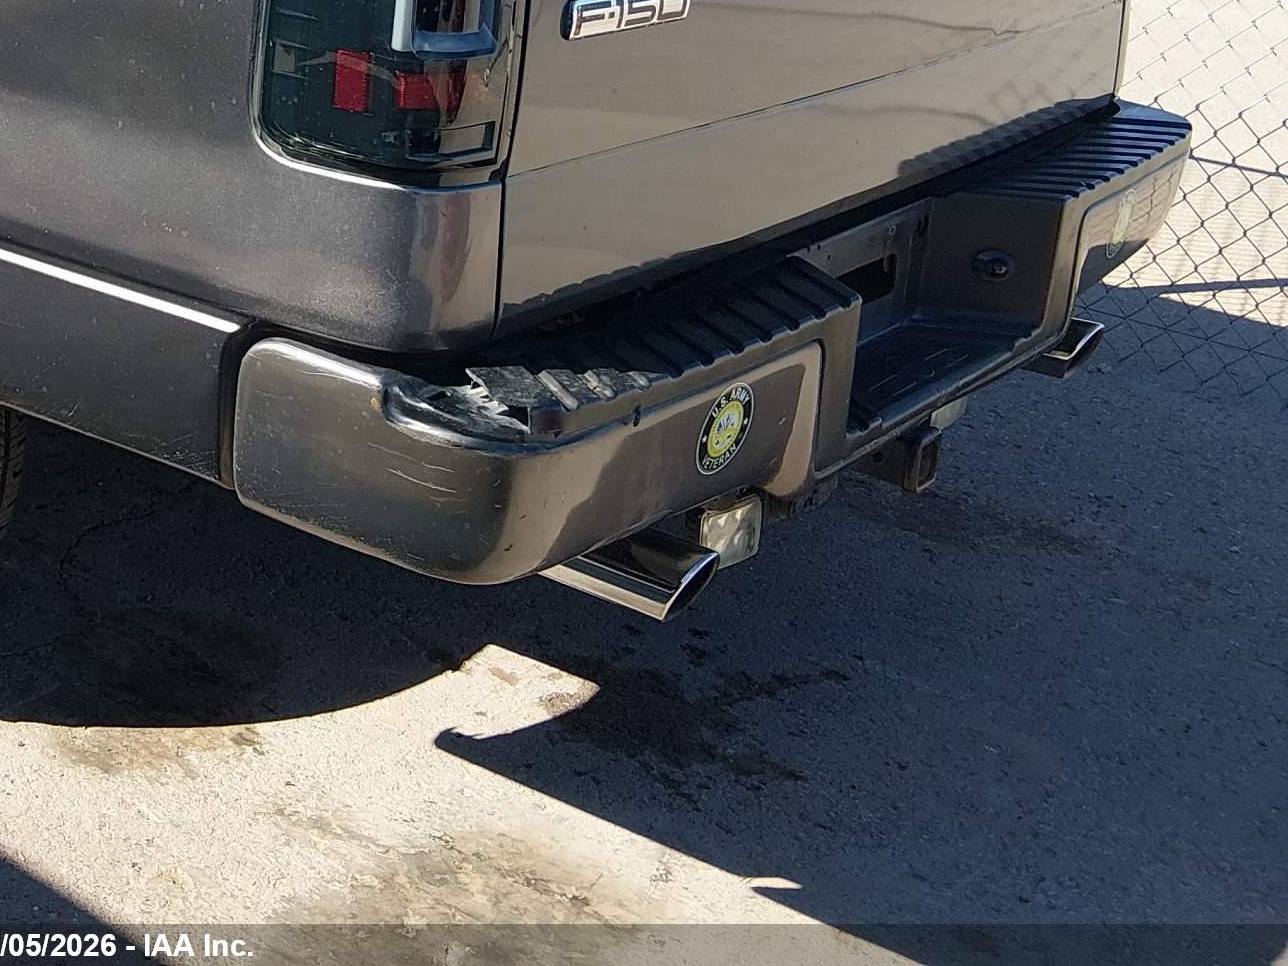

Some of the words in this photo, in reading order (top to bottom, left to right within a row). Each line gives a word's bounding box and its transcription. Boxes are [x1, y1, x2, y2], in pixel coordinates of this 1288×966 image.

[712, 396, 729, 418] U.S.
[729, 387, 750, 404] ARMY
[701, 443, 737, 469] VETERAN
